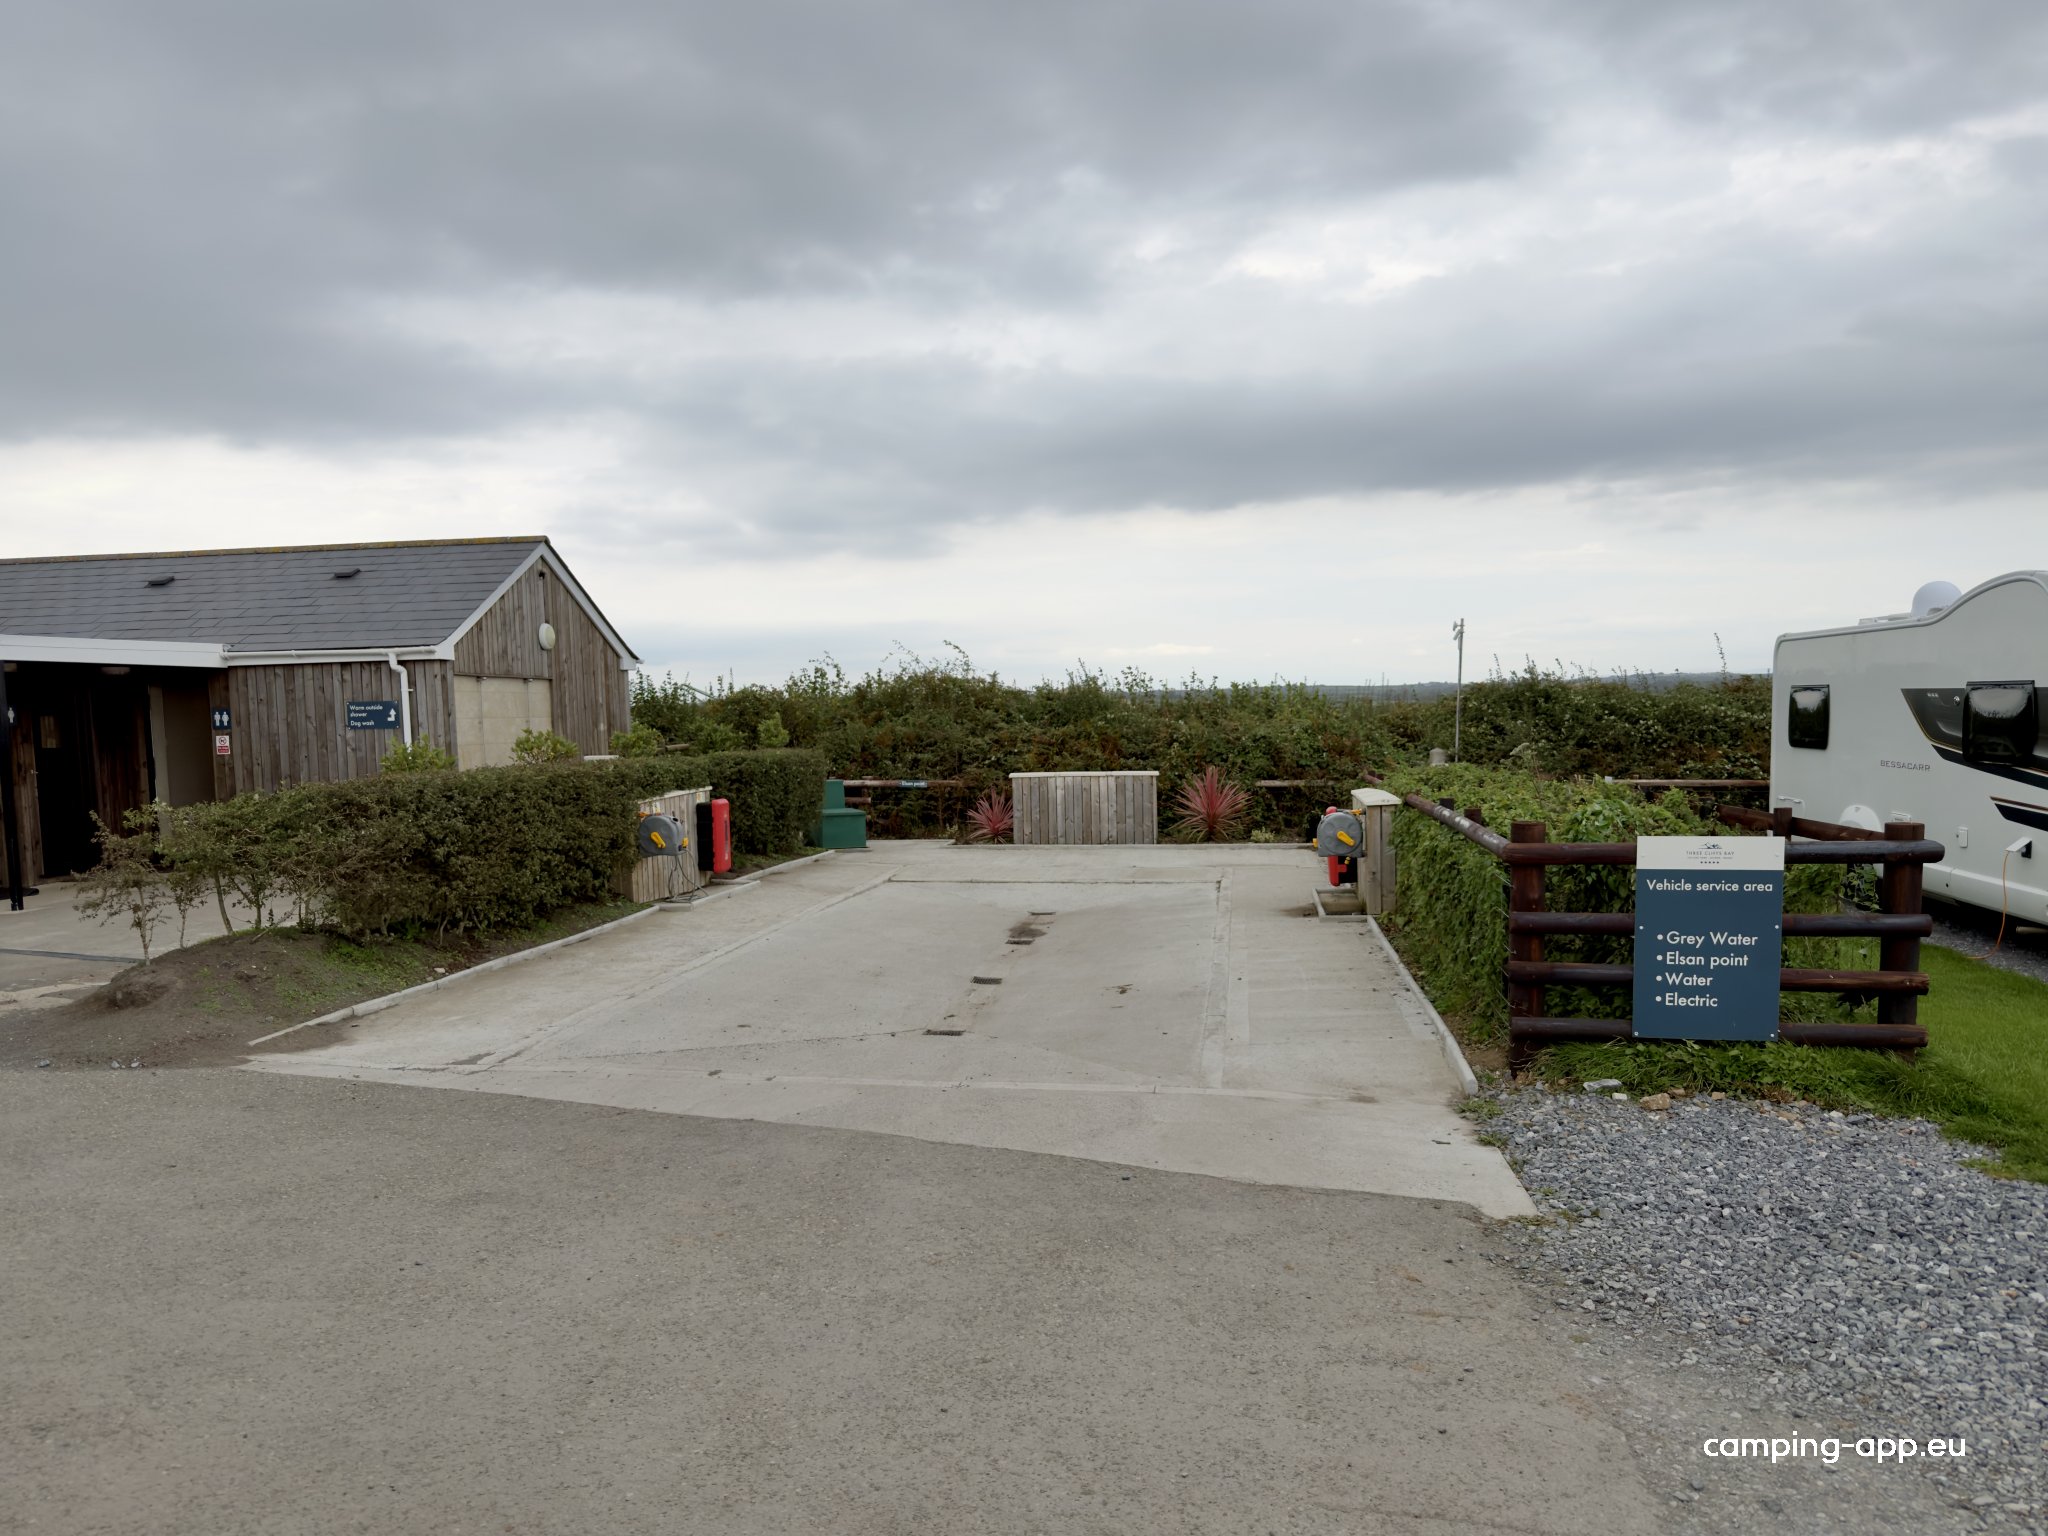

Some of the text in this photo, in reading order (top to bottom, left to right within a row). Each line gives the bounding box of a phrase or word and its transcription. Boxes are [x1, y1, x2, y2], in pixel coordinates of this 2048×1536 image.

[1646, 878, 1773, 892] Vehicle service area
[1666, 930, 1758, 949] Grey Water
[1666, 950, 1749, 970] Elsan point
[1665, 971, 1713, 987] Water
[1665, 991, 1718, 1007] Electric
